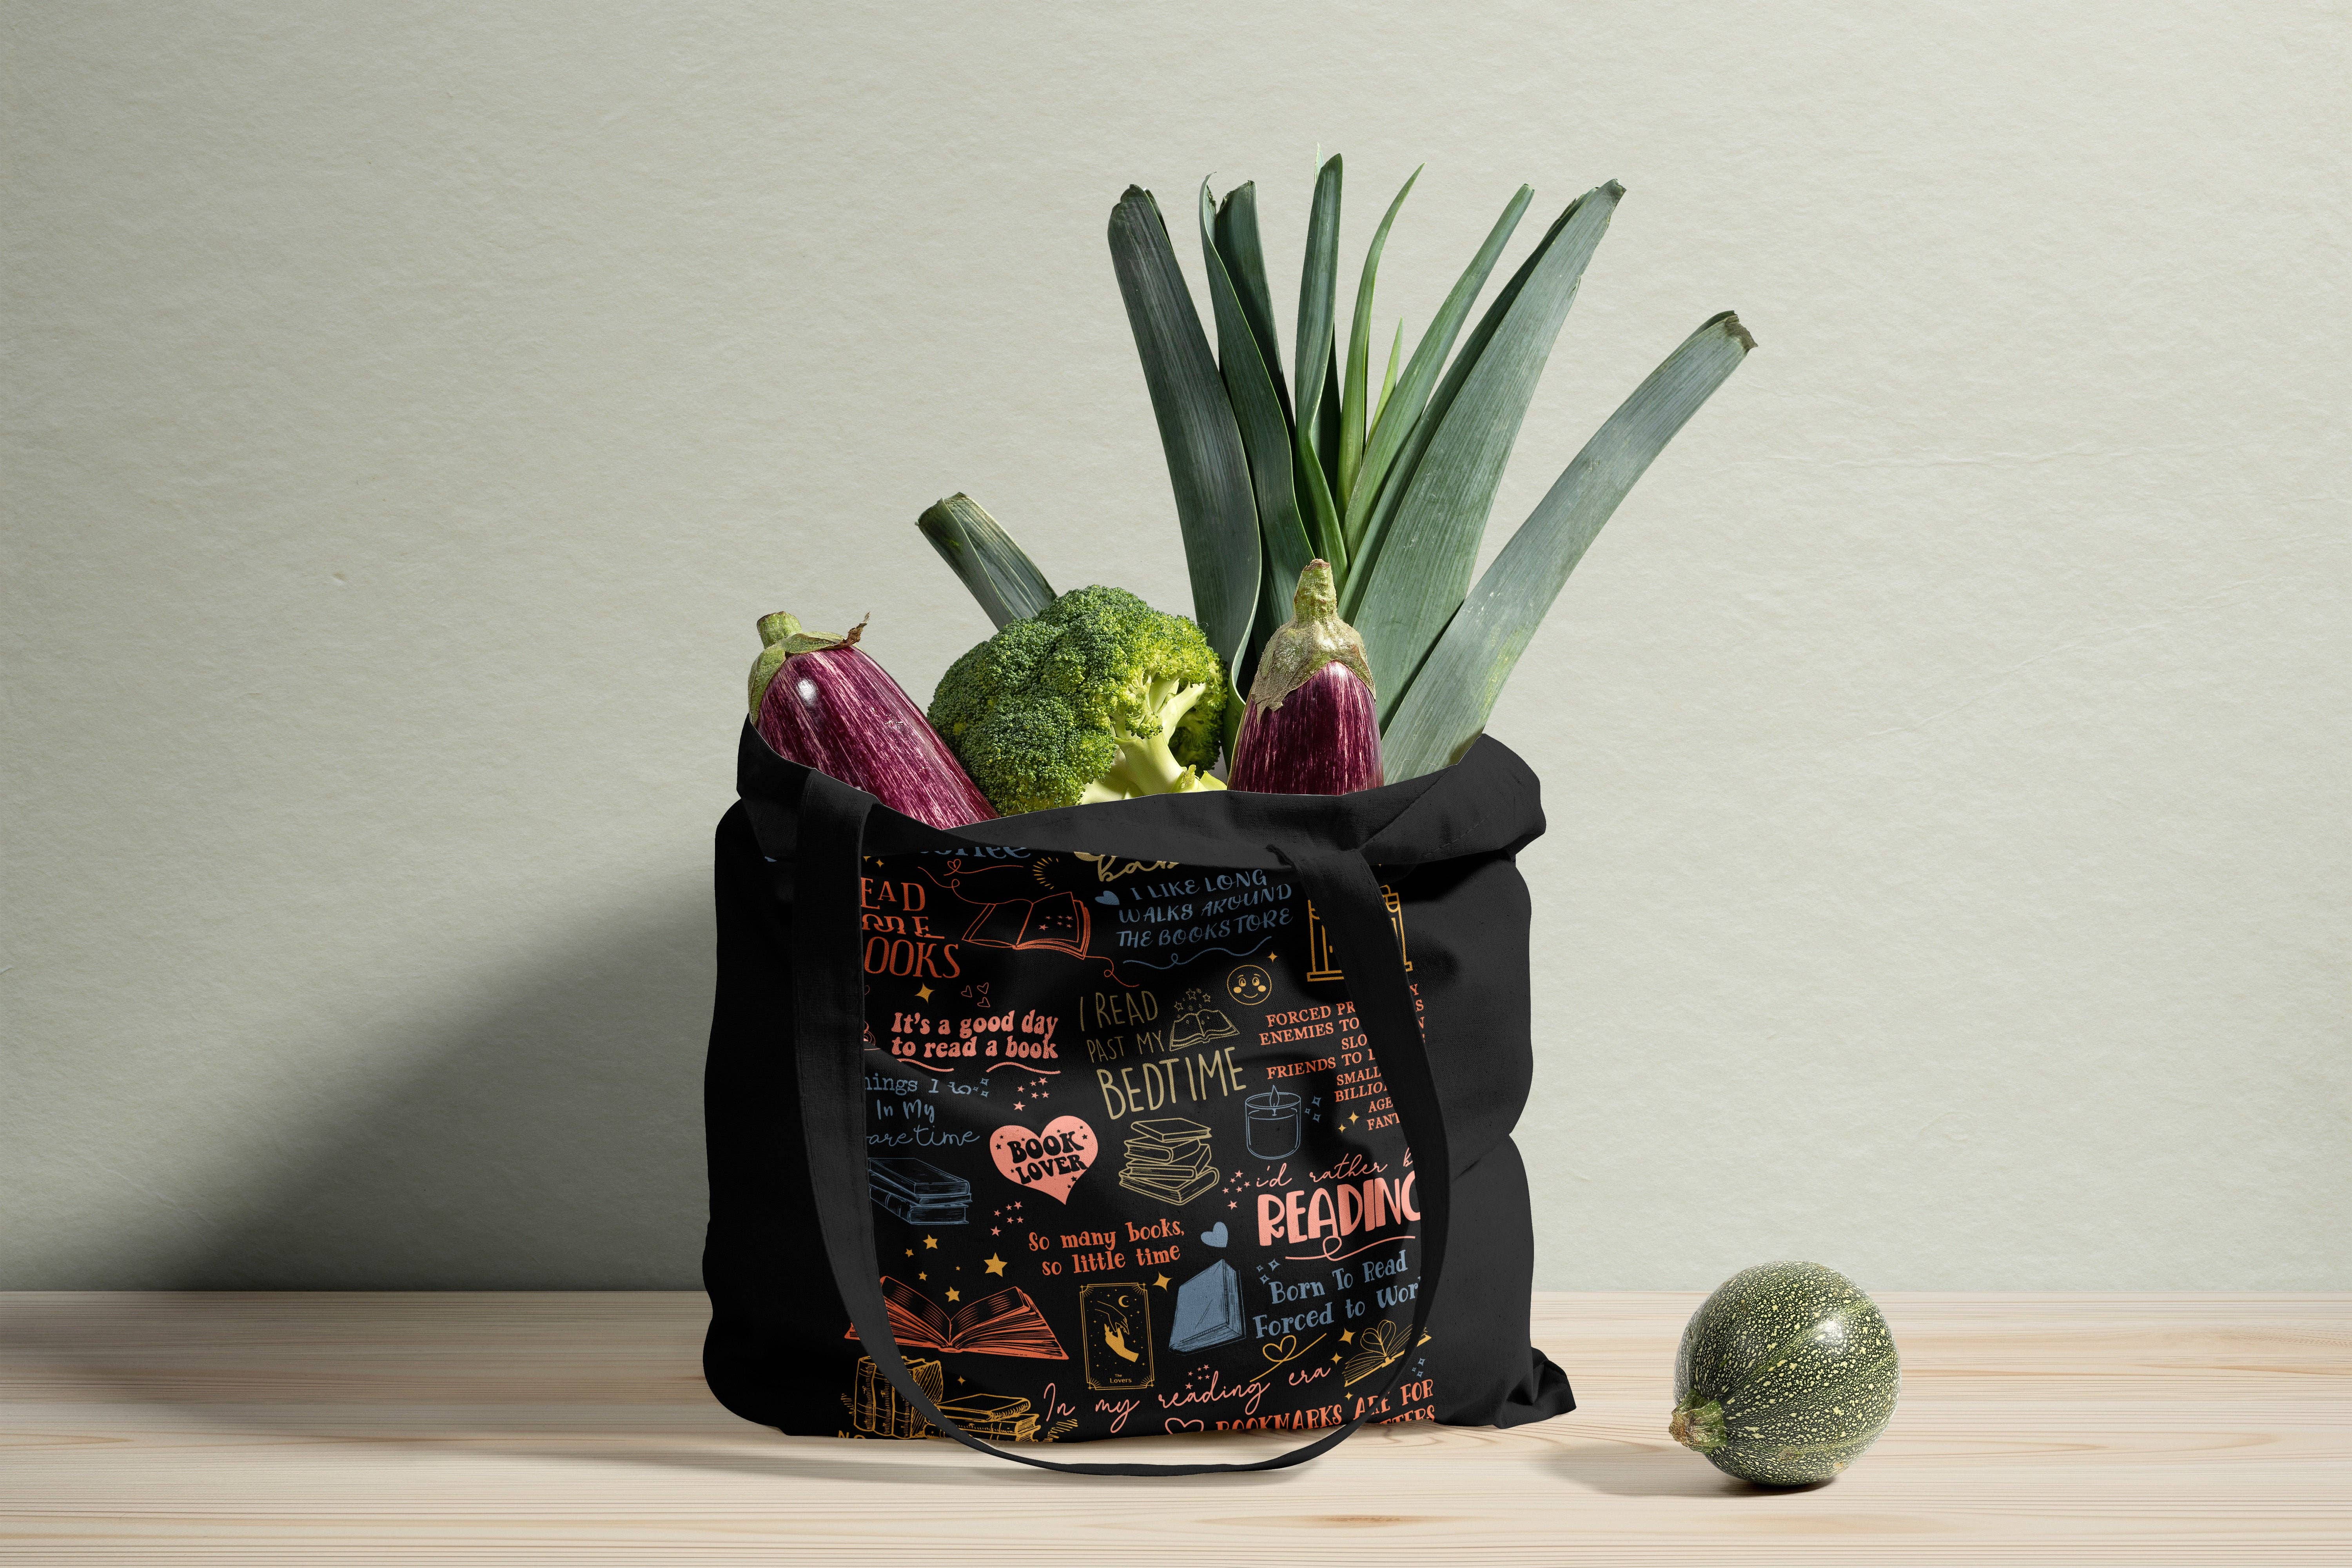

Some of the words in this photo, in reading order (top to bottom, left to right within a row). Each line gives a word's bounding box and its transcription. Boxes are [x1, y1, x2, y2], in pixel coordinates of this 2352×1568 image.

[860, 877, 926, 911] EAD
[1131, 887, 1142, 900] I
[1147, 879, 1200, 898] LIKE
[1205, 869, 1267, 892] LONG
[1119, 904, 1193, 923] WALKS
[1201, 884, 1292, 916] AROUND
[1116, 930, 1153, 948] THE
[1158, 908, 1293, 946] BOOKSTORE
[864, 936, 960, 978] OOKS
[891, 1012, 930, 1035] It's
[938, 1019, 951, 1035] a
[959, 1010, 1015, 1039] good
[1021, 1009, 1059, 1040] day
[1080, 997, 1084, 1031] I
[1096, 991, 1158, 1027] READ
[1265, 1005, 1331, 1027] FORCED
[891, 1036, 916, 1056] to
[923, 1036, 977, 1058] read
[985, 1040, 998, 1057] a
[1005, 1034, 1059, 1059] book
[1087, 1036, 1123, 1062] PAST
[1137, 1030, 1164, 1053] MY
[1258, 1022, 1334, 1046] ENEMIES
[1338, 1017, 1360, 1032] TO
[1266, 1056, 1336, 1080] FRIENDS
[1341, 1051, 1362, 1066] TO
[1336, 1066, 1381, 1086] SMALL
[928, 1079, 939, 1094] I
[1096, 1047, 1247, 1120] BEDTIME
[1334, 1081, 1388, 1102] BILLIO
[876, 1099, 894, 1120] In
[903, 1099, 935, 1124] My
[1368, 1096, 1394, 1113] AGE
[913, 1124, 980, 1147] time
[1367, 1112, 1400, 1131] FANT
[1007, 1131, 1084, 1163] BOOK
[1016, 1154, 1088, 1185] LOVER
[1309, 1153, 1388, 1183] rather
[1029, 1232, 1050, 1251] So
[1060, 1230, 1116, 1251] many
[1125, 1218, 1185, 1242] books,
[1042, 1261, 1062, 1276] so
[1071, 1250, 1126, 1274] little
[1136, 1245, 1181, 1266] time
[1268, 1281, 1326, 1305] Born
[1332, 1268, 1353, 1291] To
[1363, 1249, 1408, 1283] Read
[1252, 1301, 1334, 1339] Forced
[1345, 1298, 1365, 1319] to
[1376, 1276, 1421, 1309] Wor
[1044, 1382, 1076, 1422] In
[1095, 1399, 1140, 1434] my
[1158, 1370, 1270, 1416] reading
[1289, 1367, 1331, 1386] era
[1400, 1379, 1434, 1406] FOR
